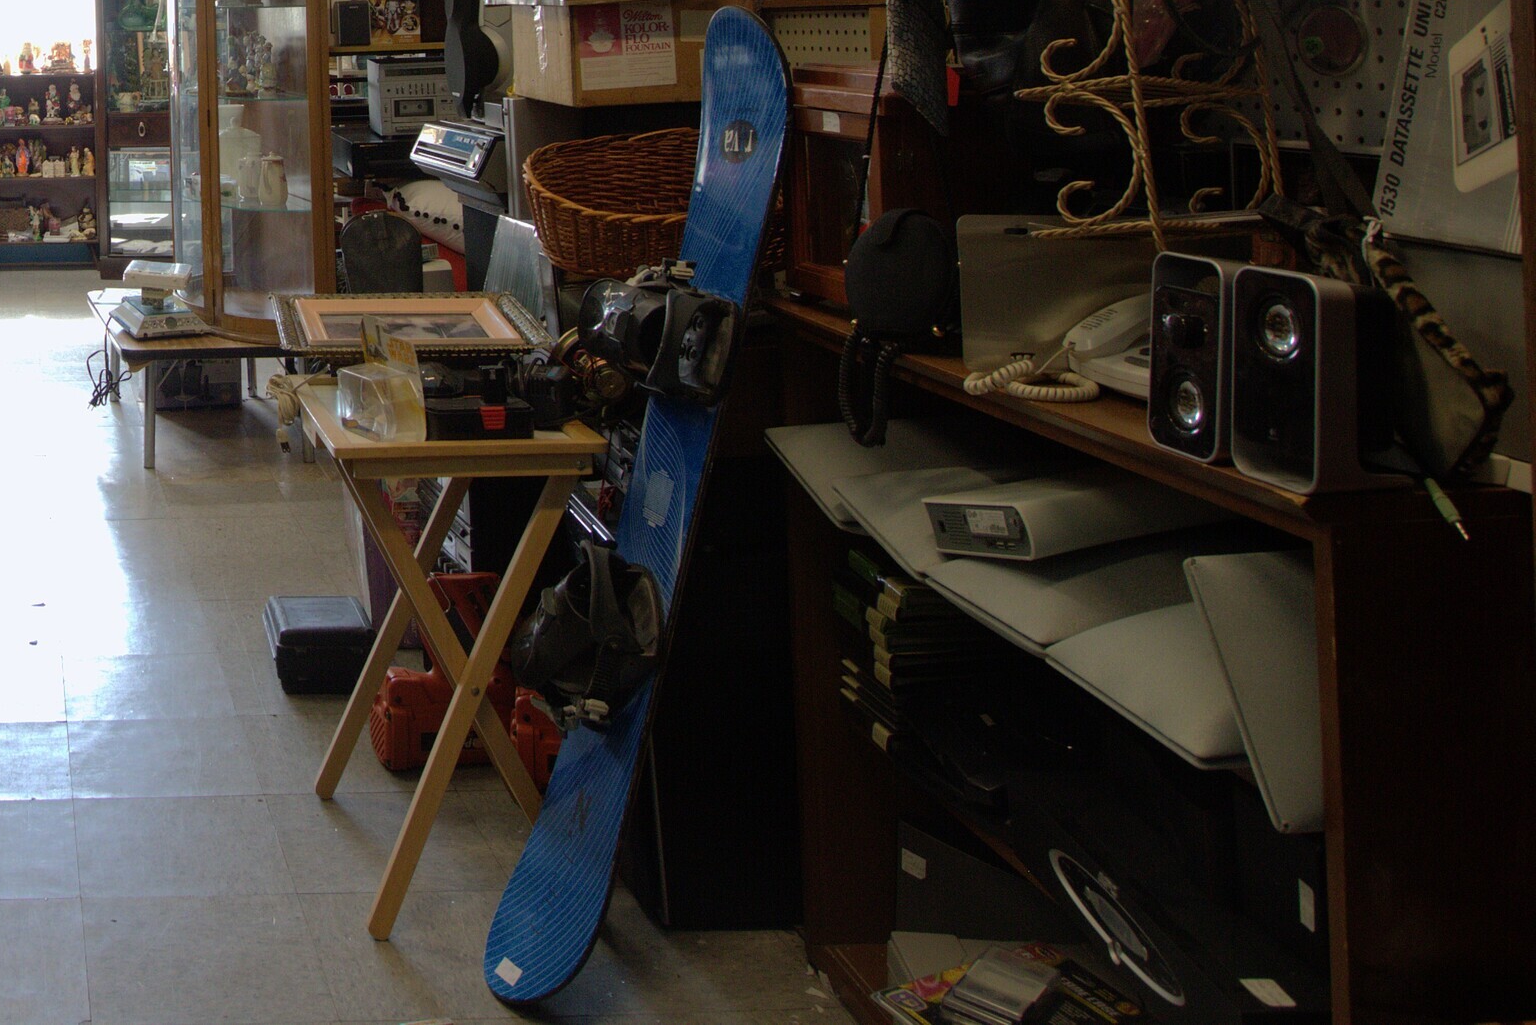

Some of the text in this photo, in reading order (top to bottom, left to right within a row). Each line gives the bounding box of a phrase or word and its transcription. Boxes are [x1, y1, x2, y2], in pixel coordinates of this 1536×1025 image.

[624, 21, 670, 34] KOLOR-
[625, 32, 650, 44] FLO
[625, 42, 671, 52] FOUNTAIN
[1425, 33, 1444, 78] Model
[1379, 173, 1401, 217] 1530
[1390, 46, 1425, 167] DATASSETTE
